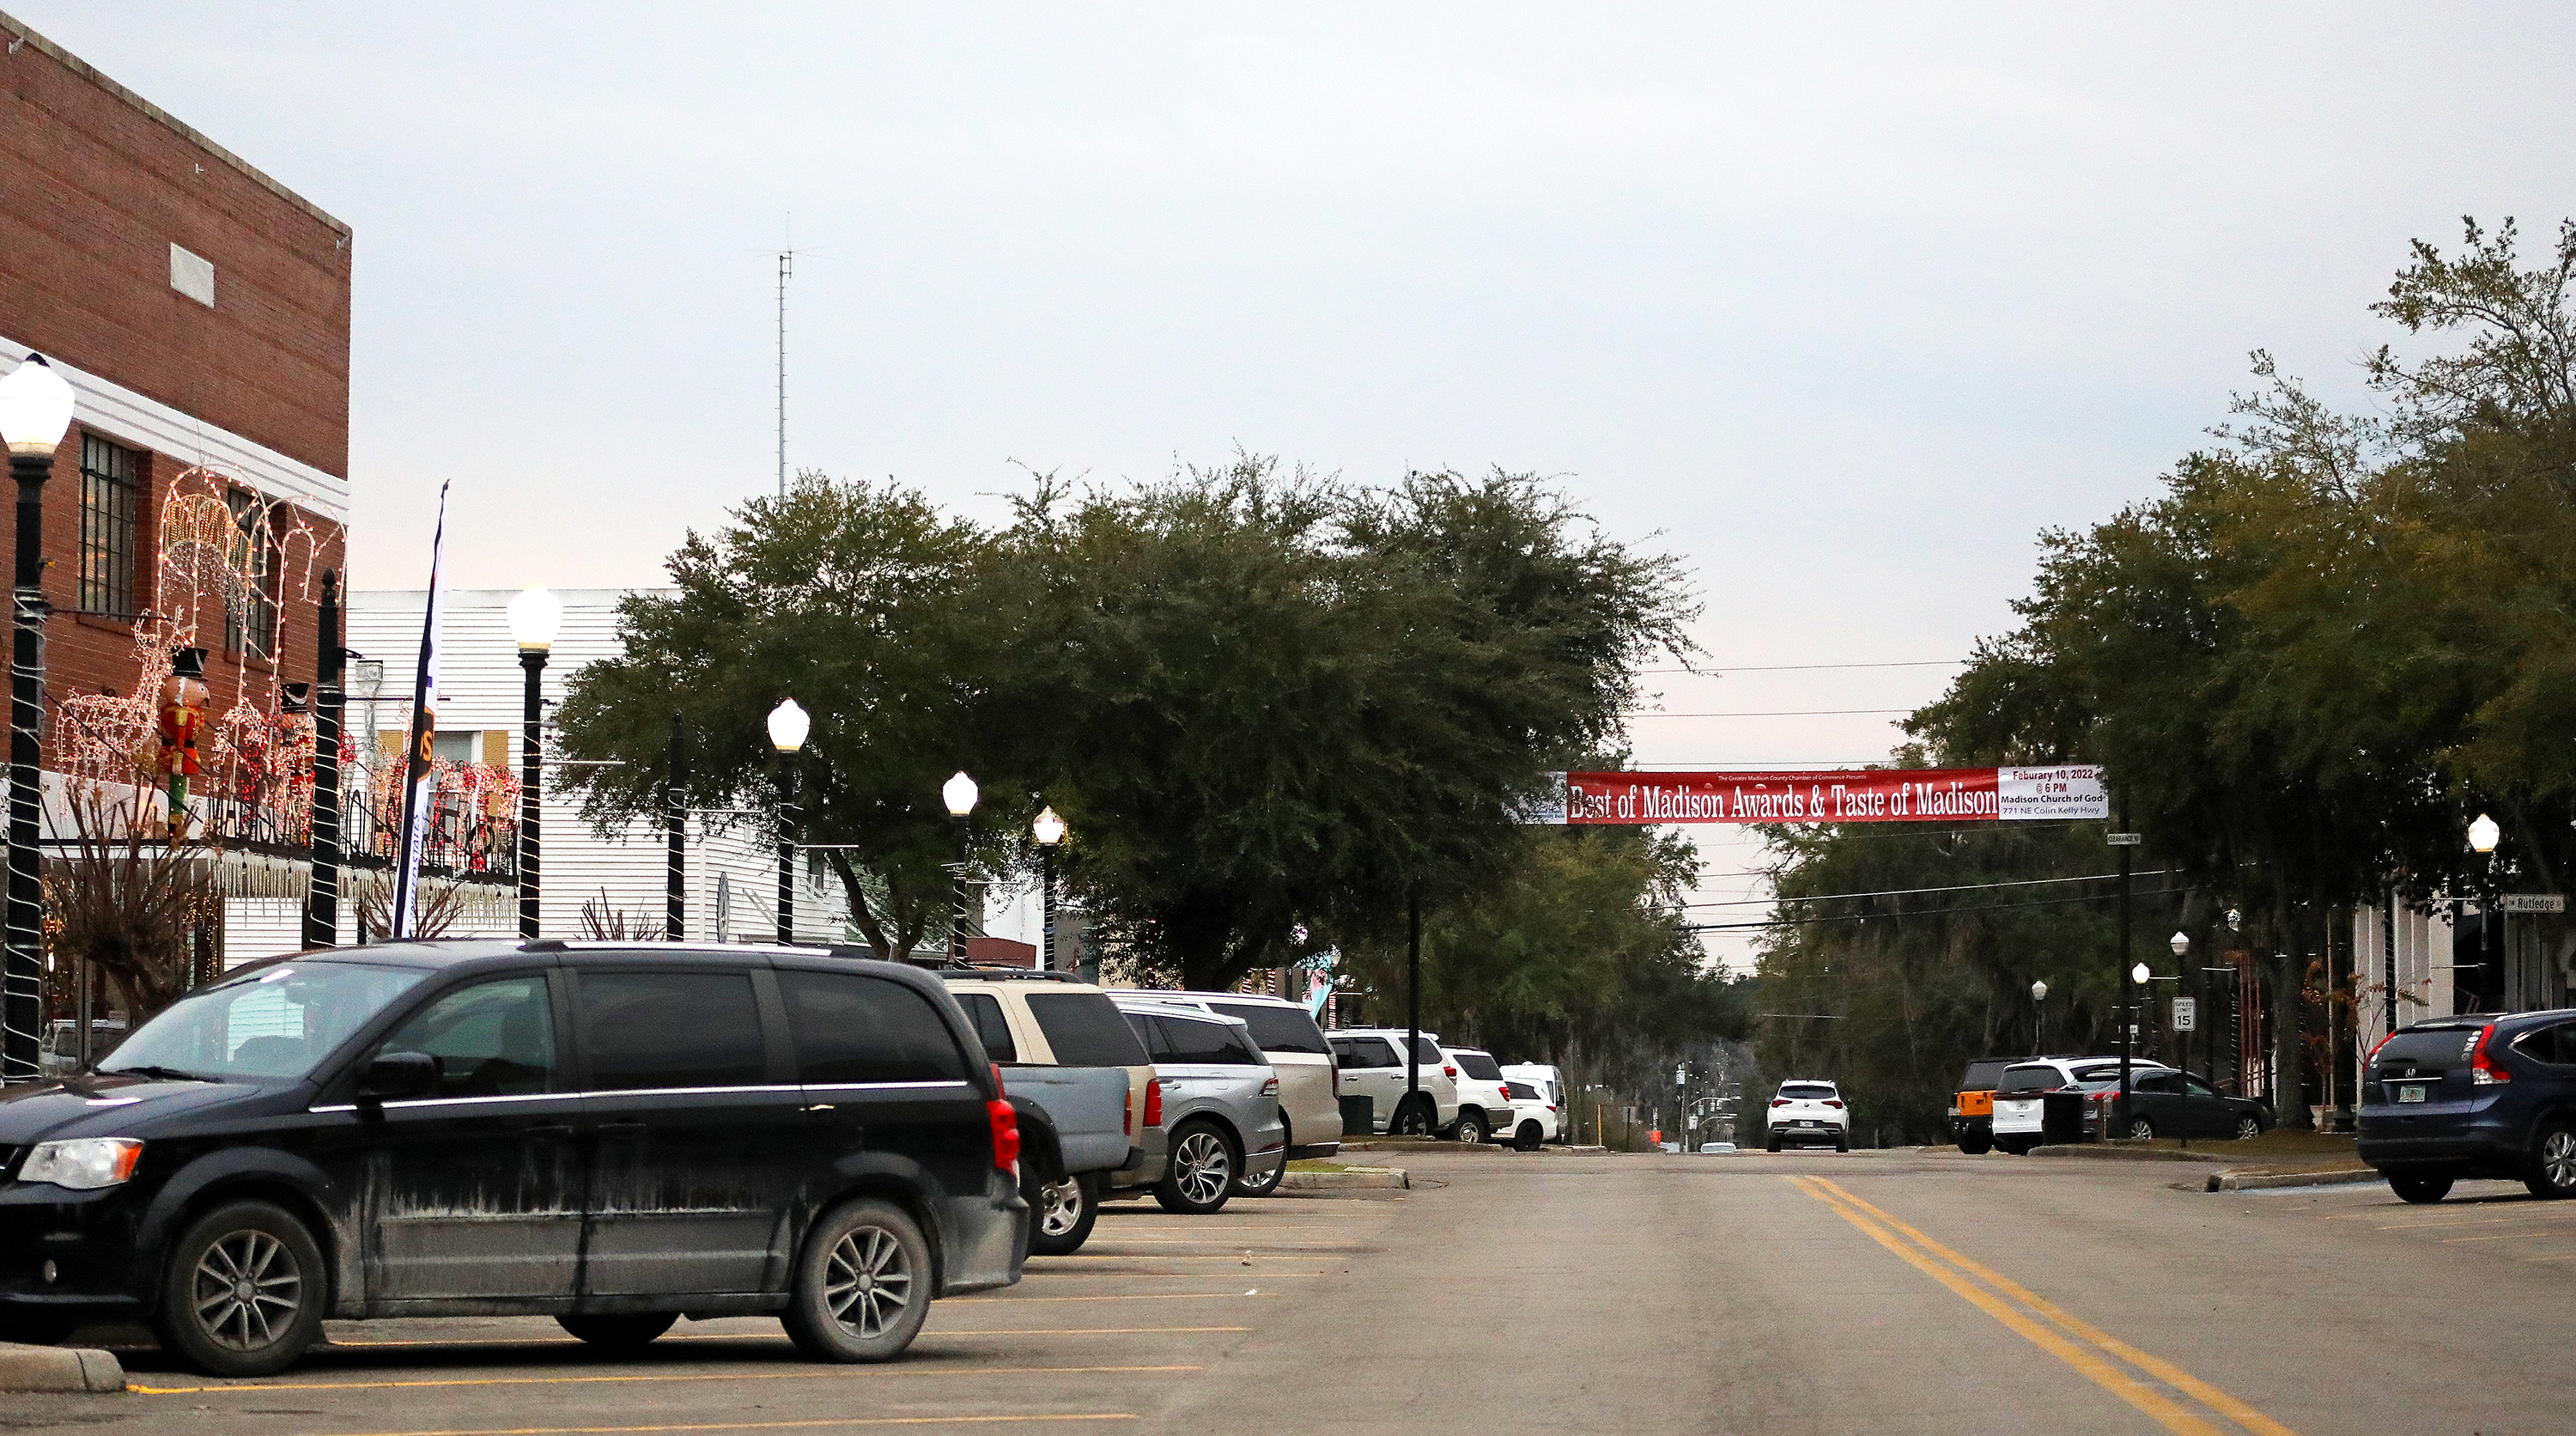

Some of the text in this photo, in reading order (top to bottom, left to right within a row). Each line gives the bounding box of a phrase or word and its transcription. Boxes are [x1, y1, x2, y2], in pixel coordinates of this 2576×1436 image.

[2013, 769, 2093, 782] Feburary 10, 2022
[2036, 782, 2067, 794] @ 6 PM
[1570, 781, 1998, 818] Best of Madison Awards & Taste of Madison
[2040, 794, 2071, 803] Church
[2073, 794, 2083, 802] of
[2084, 794, 2103, 802] God
[2034, 806, 2057, 814] Colin
[2057, 806, 2079, 815] Kelly
[2080, 806, 2100, 815] Hwy
[2518, 898, 2555, 910] Rutledge
[2177, 1015, 2191, 1025] 15
